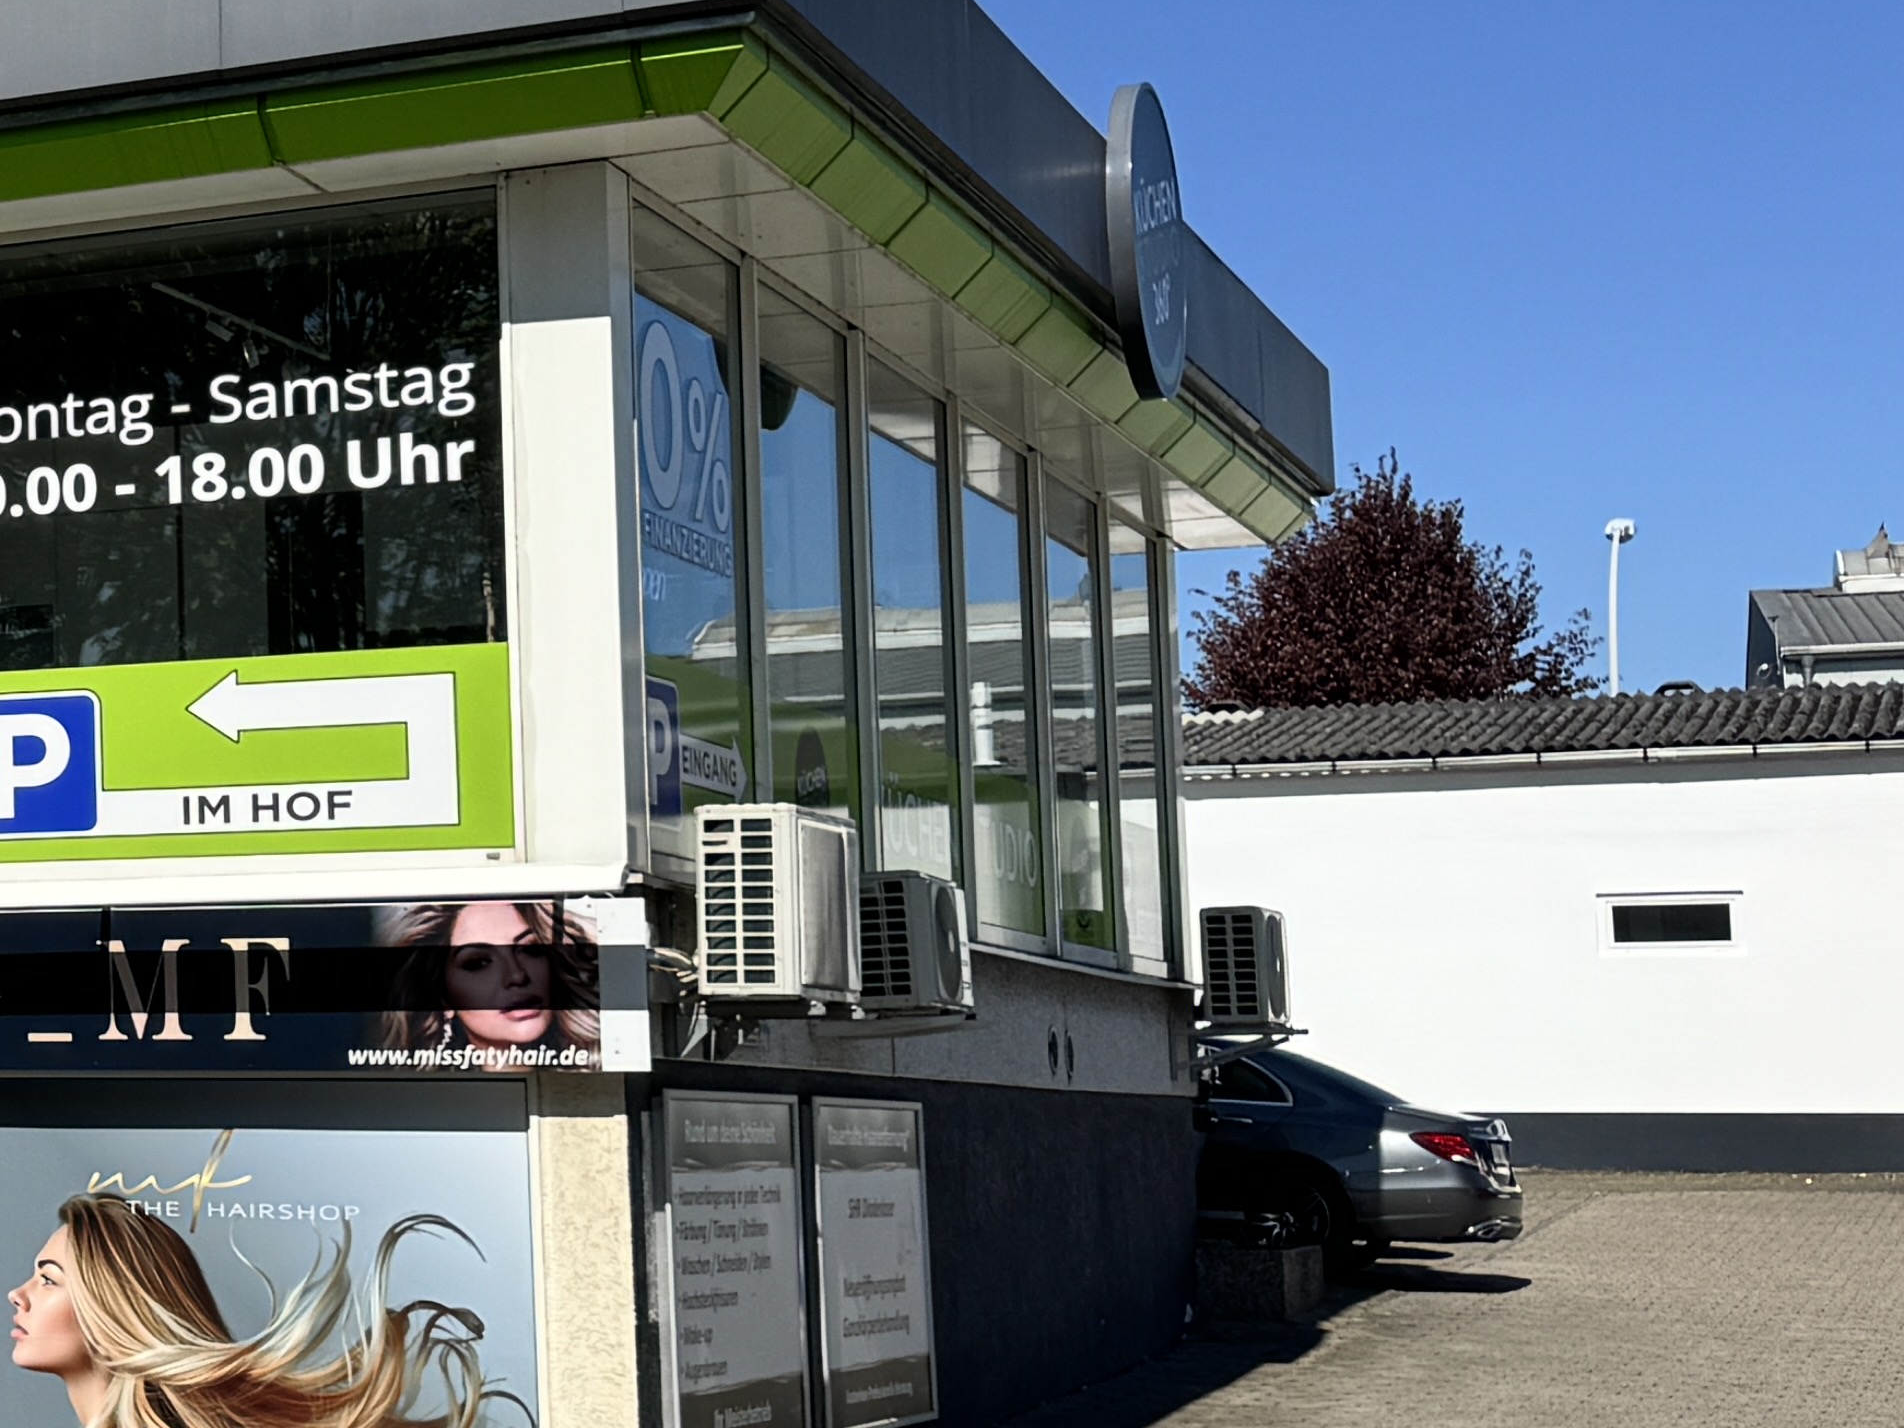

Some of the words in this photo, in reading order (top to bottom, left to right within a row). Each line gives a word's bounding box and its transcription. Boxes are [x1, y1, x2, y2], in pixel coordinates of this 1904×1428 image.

[209, 362, 475, 424] Samstag
[640, 320, 730, 535] 0%
[154, 445, 324, 505] 18.00
[347, 432, 475, 490] Uhr
[681, 744, 738, 787] EINGANG
[182, 794, 231, 825] IM
[252, 790, 353, 822] HOF
[347, 1042, 590, 1070] www.missfatyhair.de
[127, 1199, 181, 1218] THE
[207, 1201, 361, 1222] HAIRSHOP
